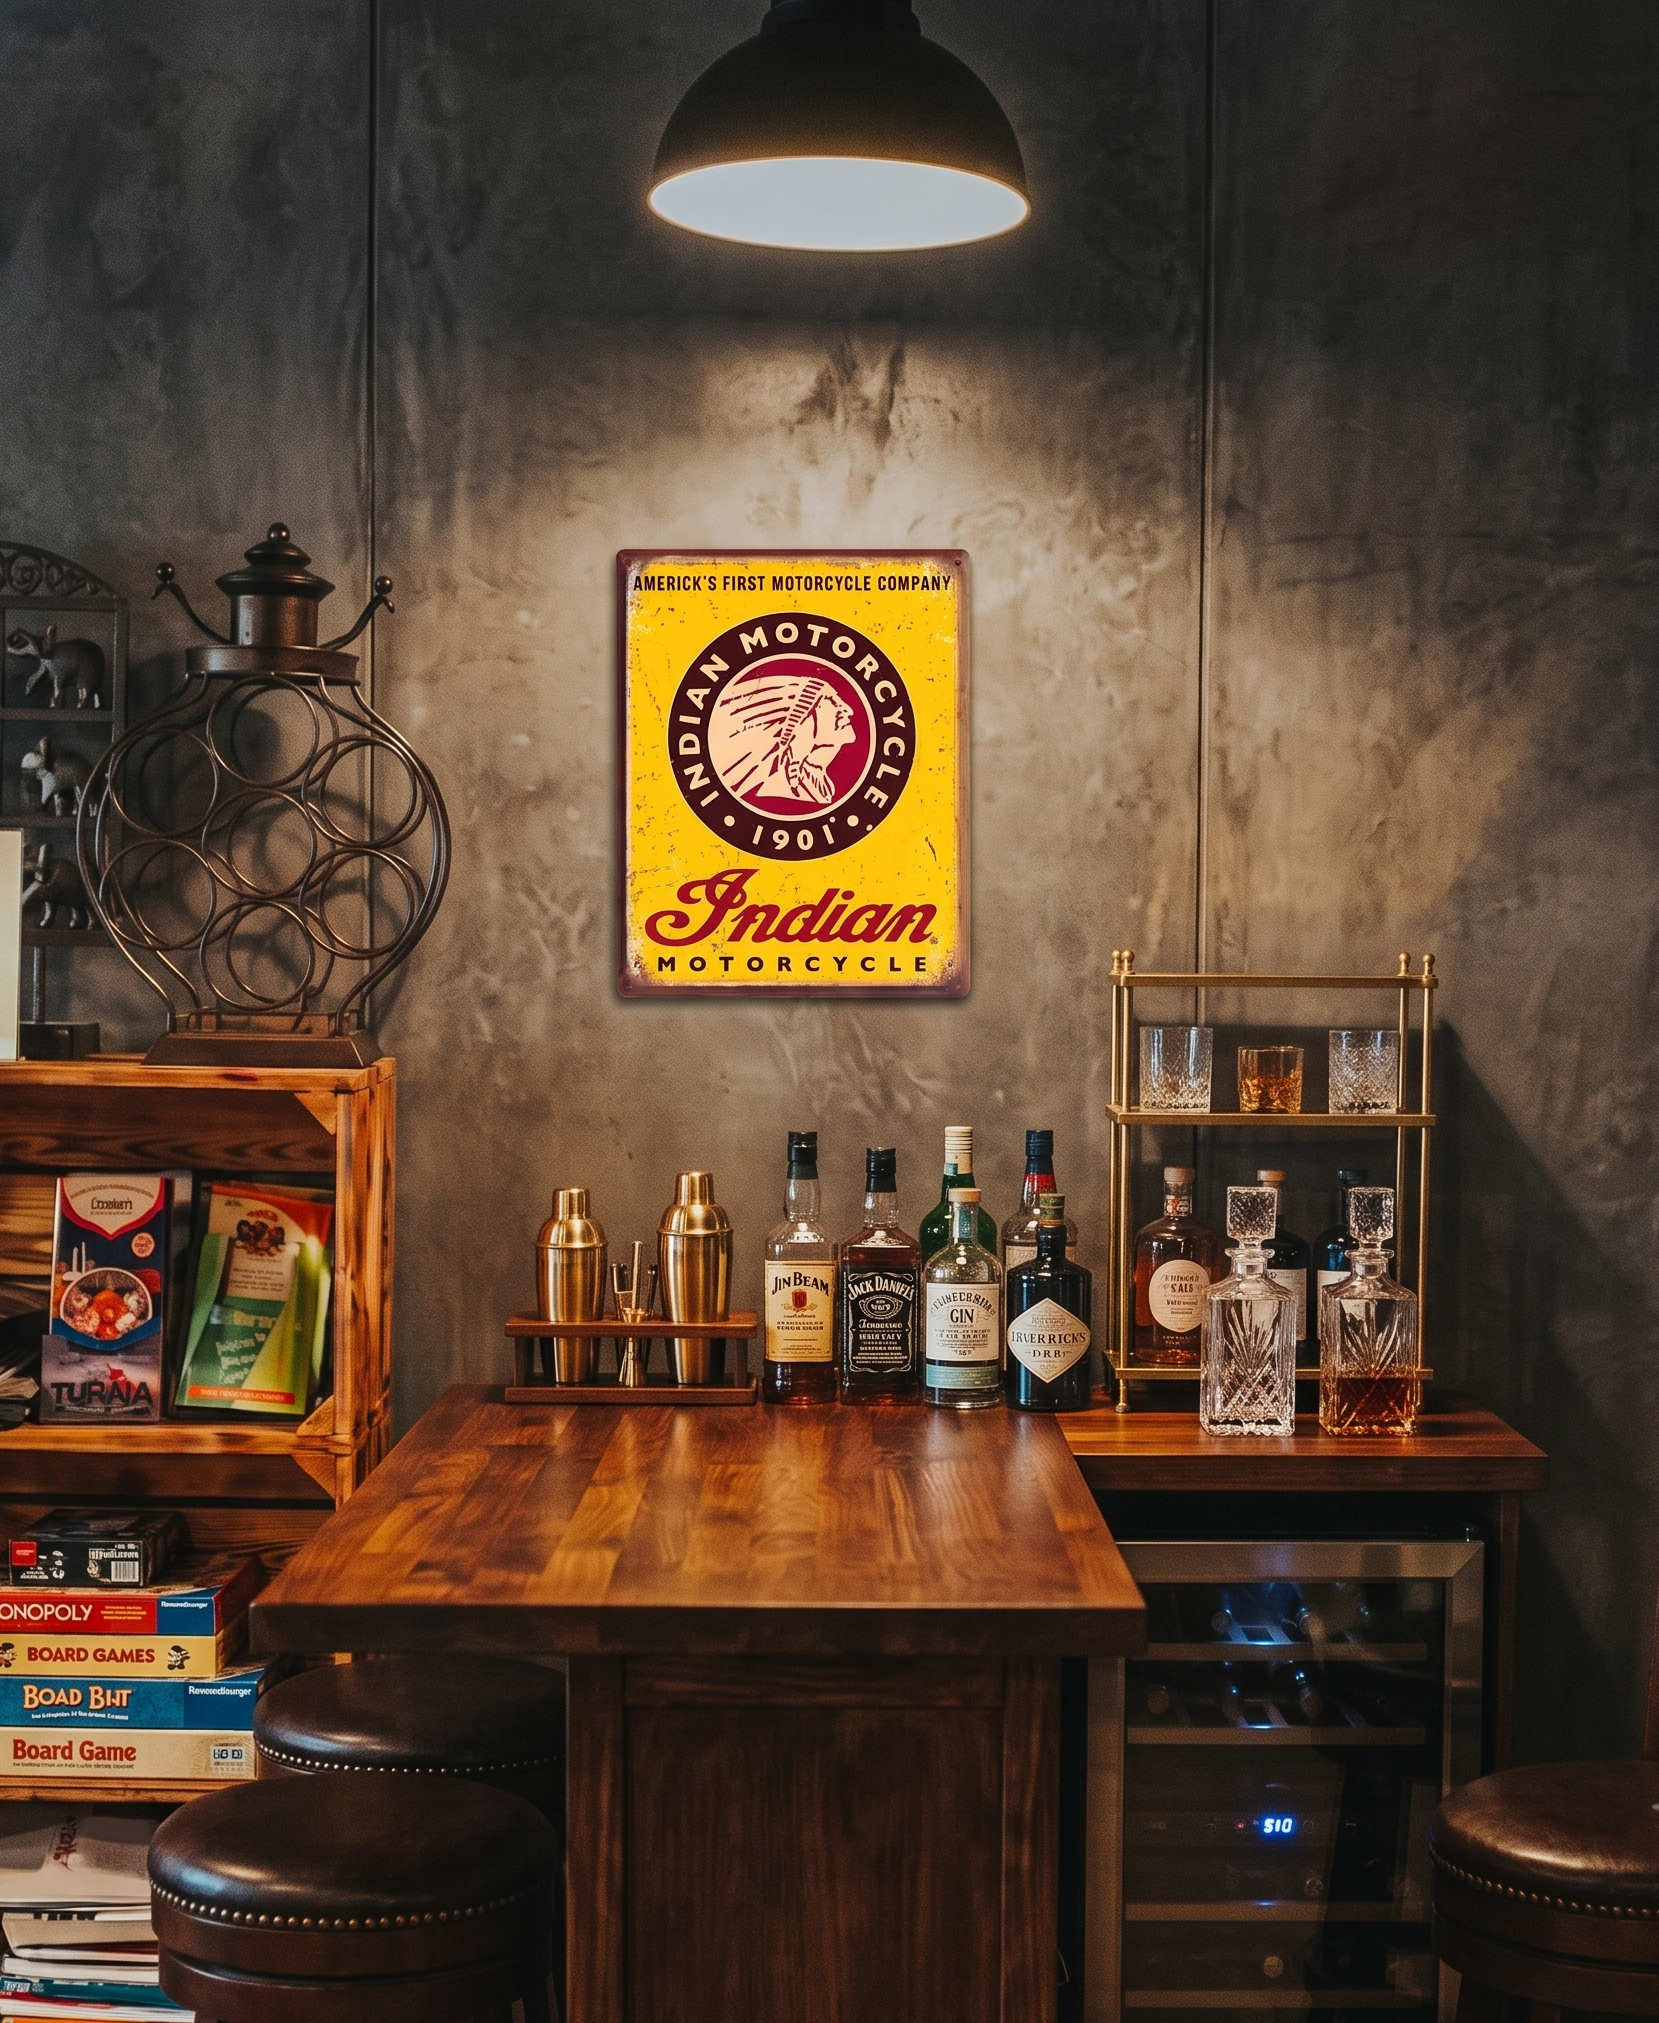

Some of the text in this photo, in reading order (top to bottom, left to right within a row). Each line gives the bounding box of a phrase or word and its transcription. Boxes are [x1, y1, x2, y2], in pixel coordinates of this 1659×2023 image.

[633, 575, 951, 591] AMERICK'S FIRST MOTORCYCLE COMPANY
[678, 622, 906, 809] INDIAN MOTORCYCLE
[645, 868, 938, 947] Indian
[657, 956, 927, 973] MOTORCYCLE
[793, 1271, 829, 1297] BEAM
[848, 1279, 875, 1301] JACK
[950, 1308, 975, 1324] GIN
[27, 1646, 156, 1663] BOARD GAMES
[23, 1684, 83, 1709] BOAD
[12, 1738, 137, 1762] Board Game
